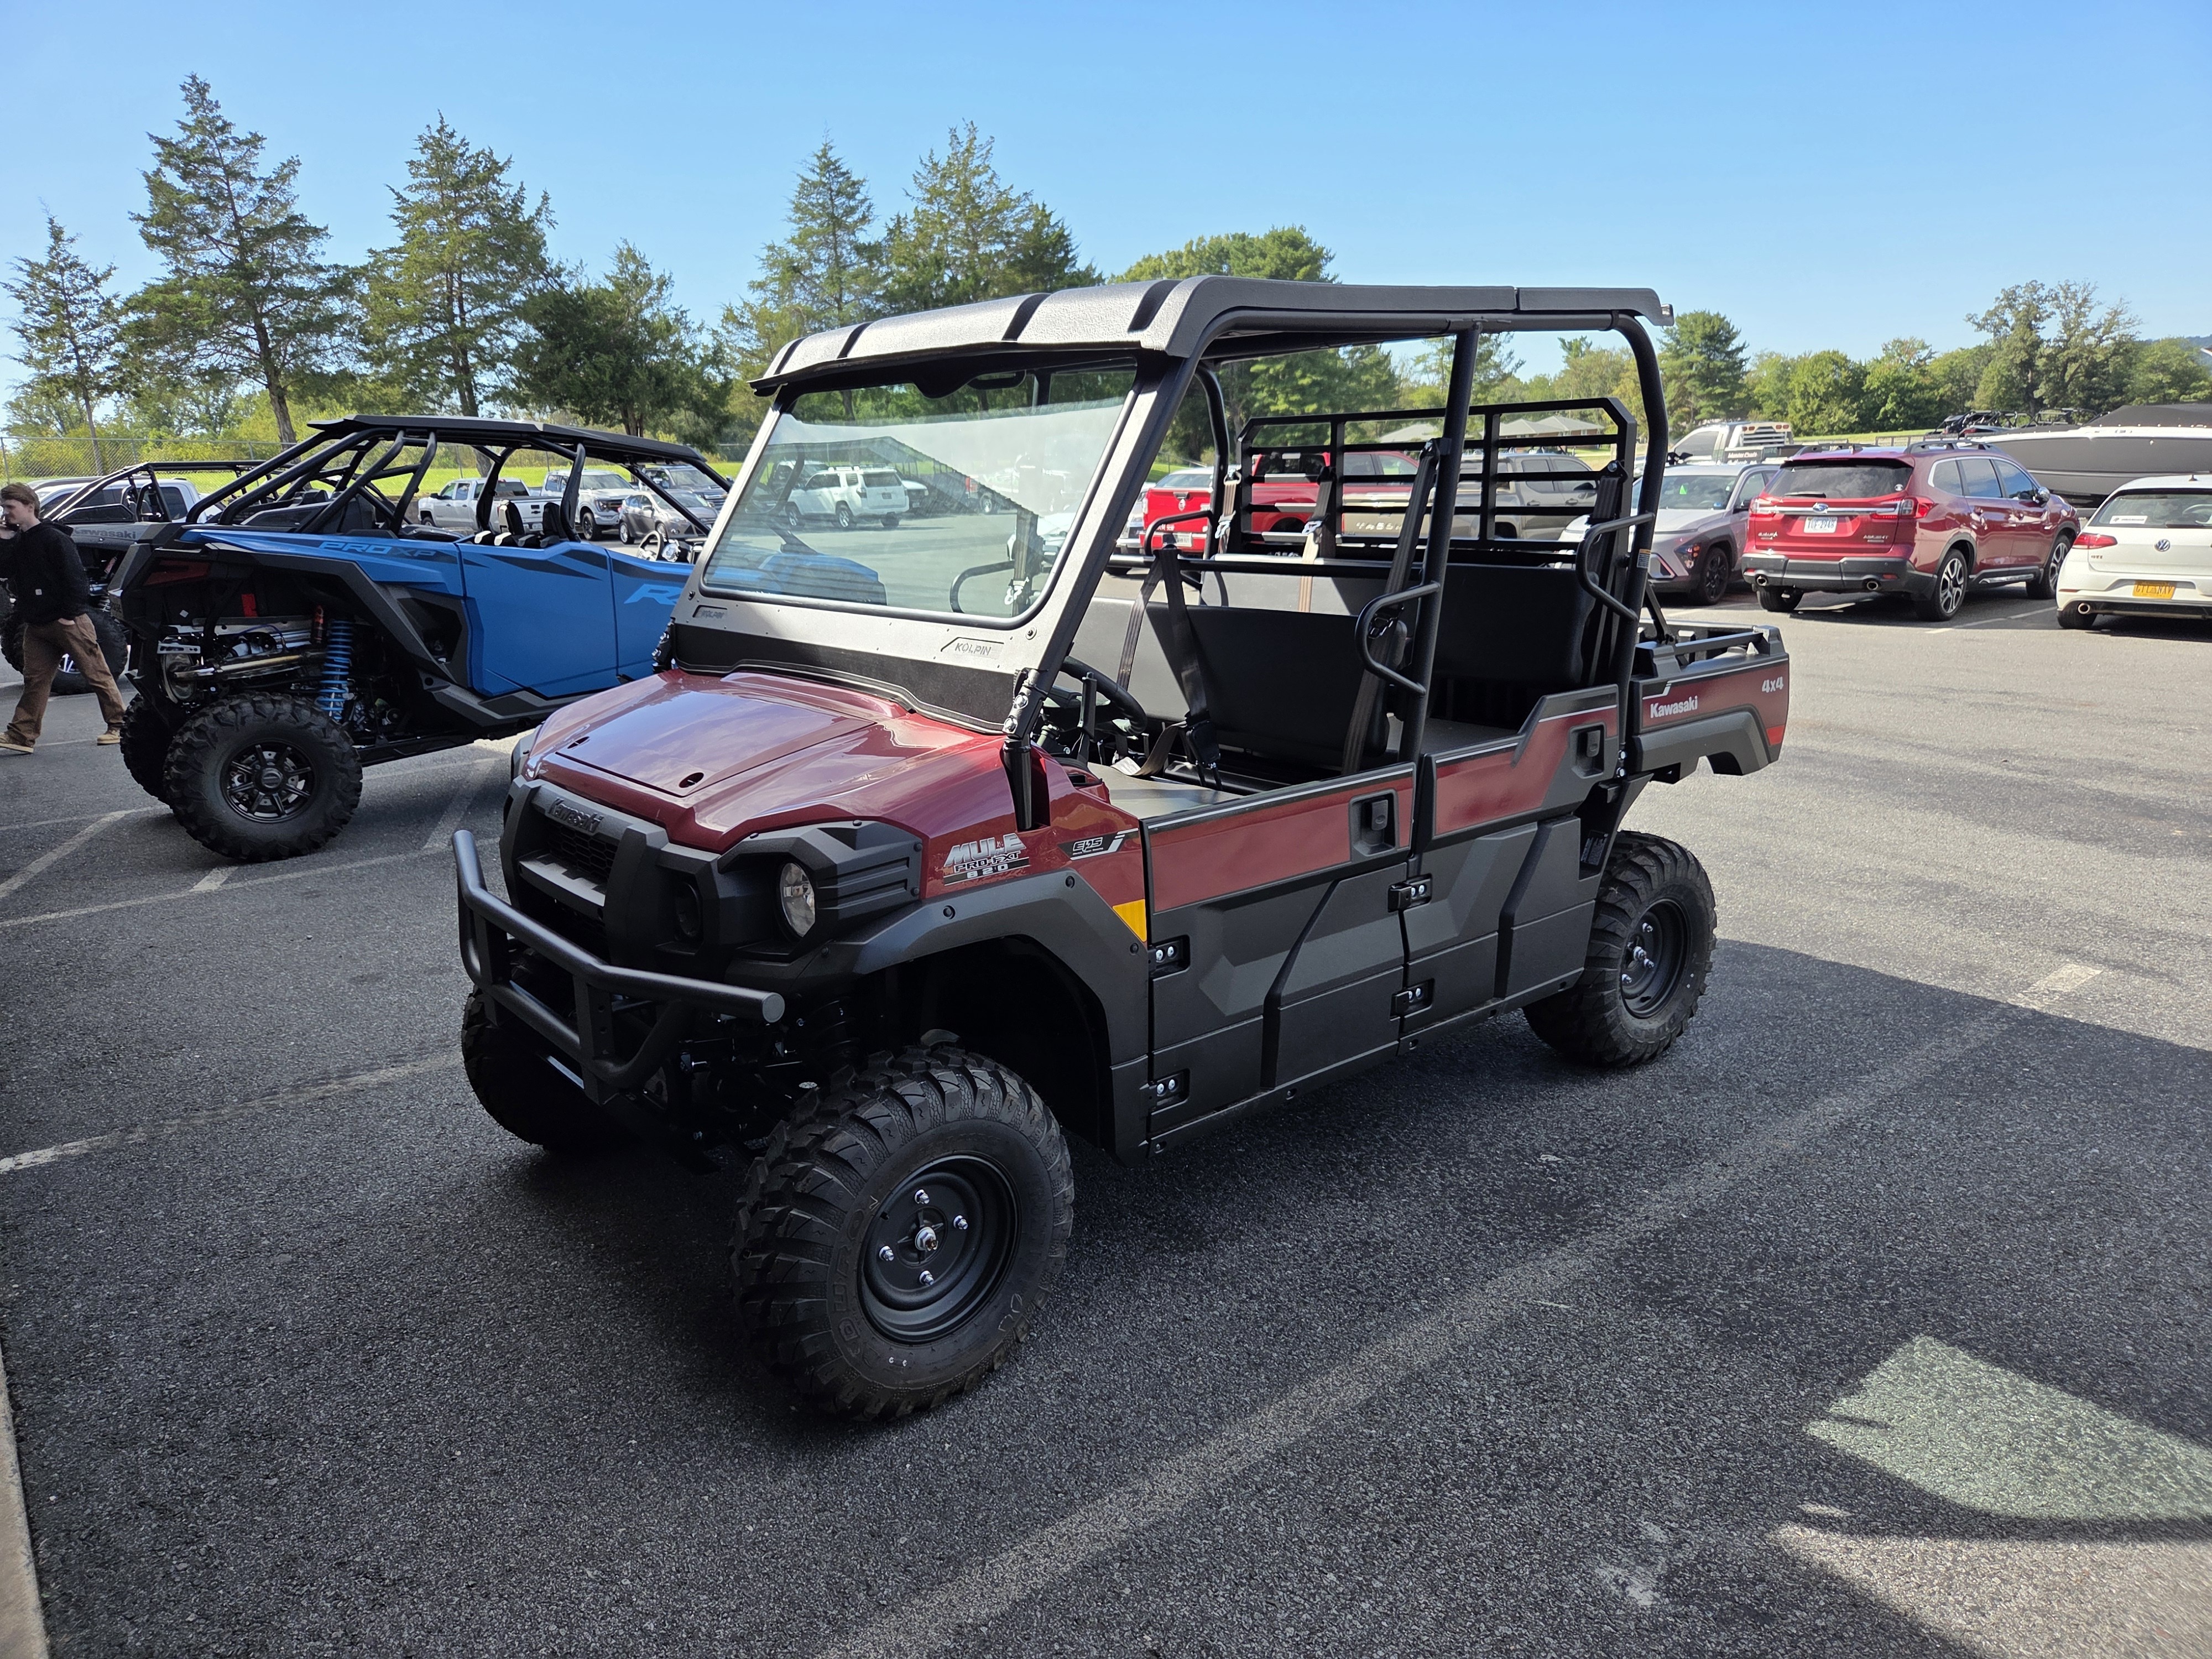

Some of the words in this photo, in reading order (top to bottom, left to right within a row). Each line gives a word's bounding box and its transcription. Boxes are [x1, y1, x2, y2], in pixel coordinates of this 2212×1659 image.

[318, 541, 393, 554] PRO
[955, 643, 992, 655] KOLPIN
[1650, 695, 1698, 718] Kawasaki
[1762, 676, 1784, 693] 4x4
[548, 796, 605, 833] Kawasaki
[943, 832, 1027, 868] MULE
[1072, 837, 1103, 852] EPS
[967, 863, 1009, 879] 820
